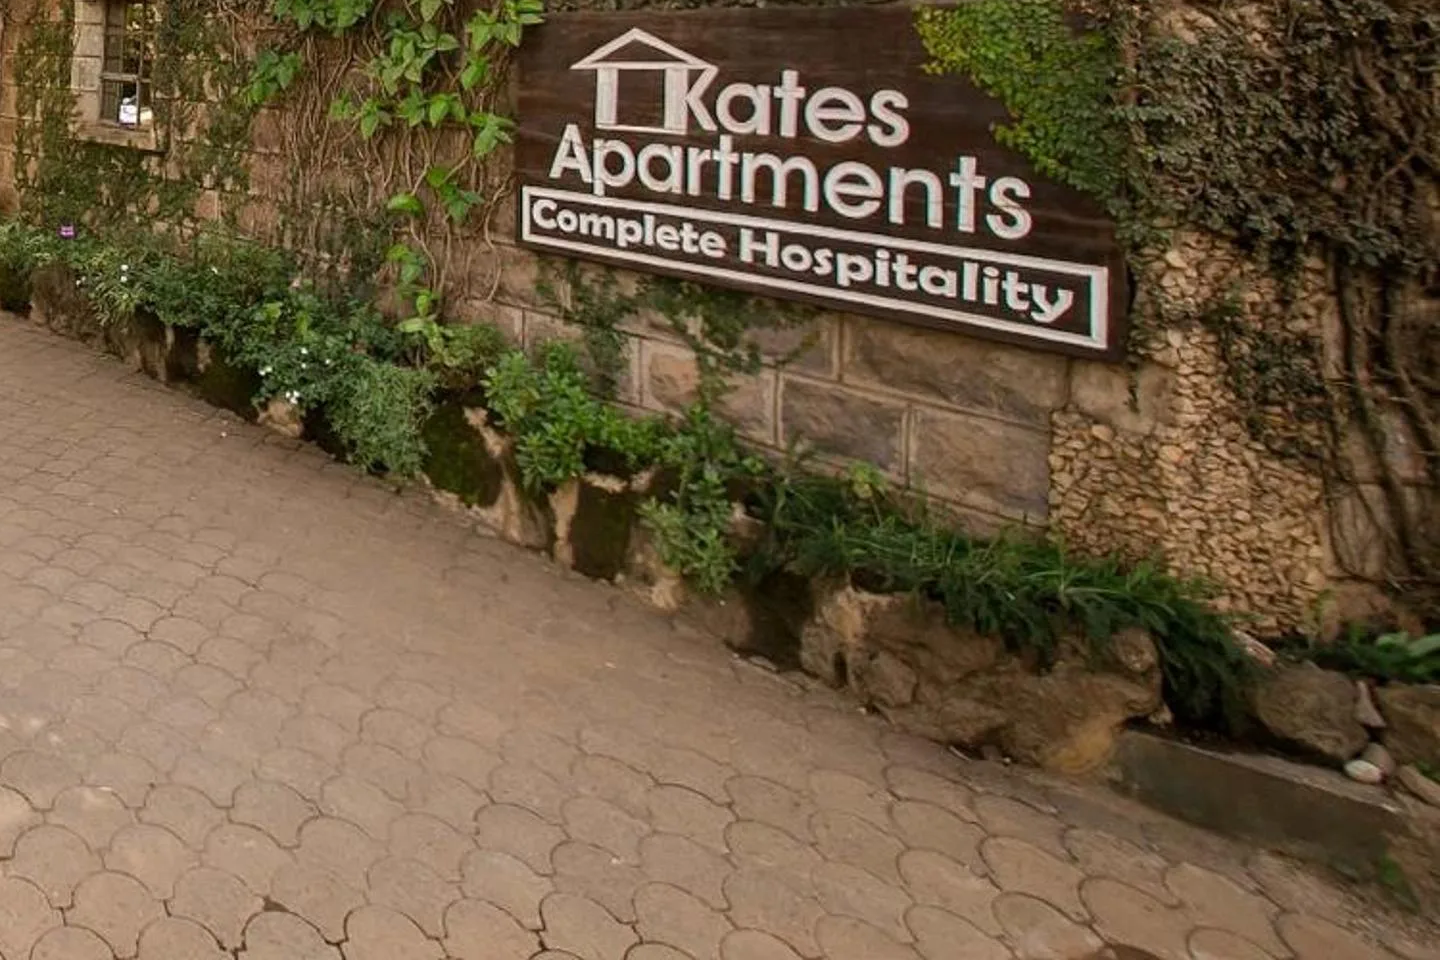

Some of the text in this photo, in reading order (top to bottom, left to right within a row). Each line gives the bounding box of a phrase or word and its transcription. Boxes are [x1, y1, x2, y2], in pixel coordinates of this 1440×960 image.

[663, 64, 911, 149] Kates
[548, 123, 1033, 241] Apartments
[531, 198, 1075, 324] Complete Hospitality
